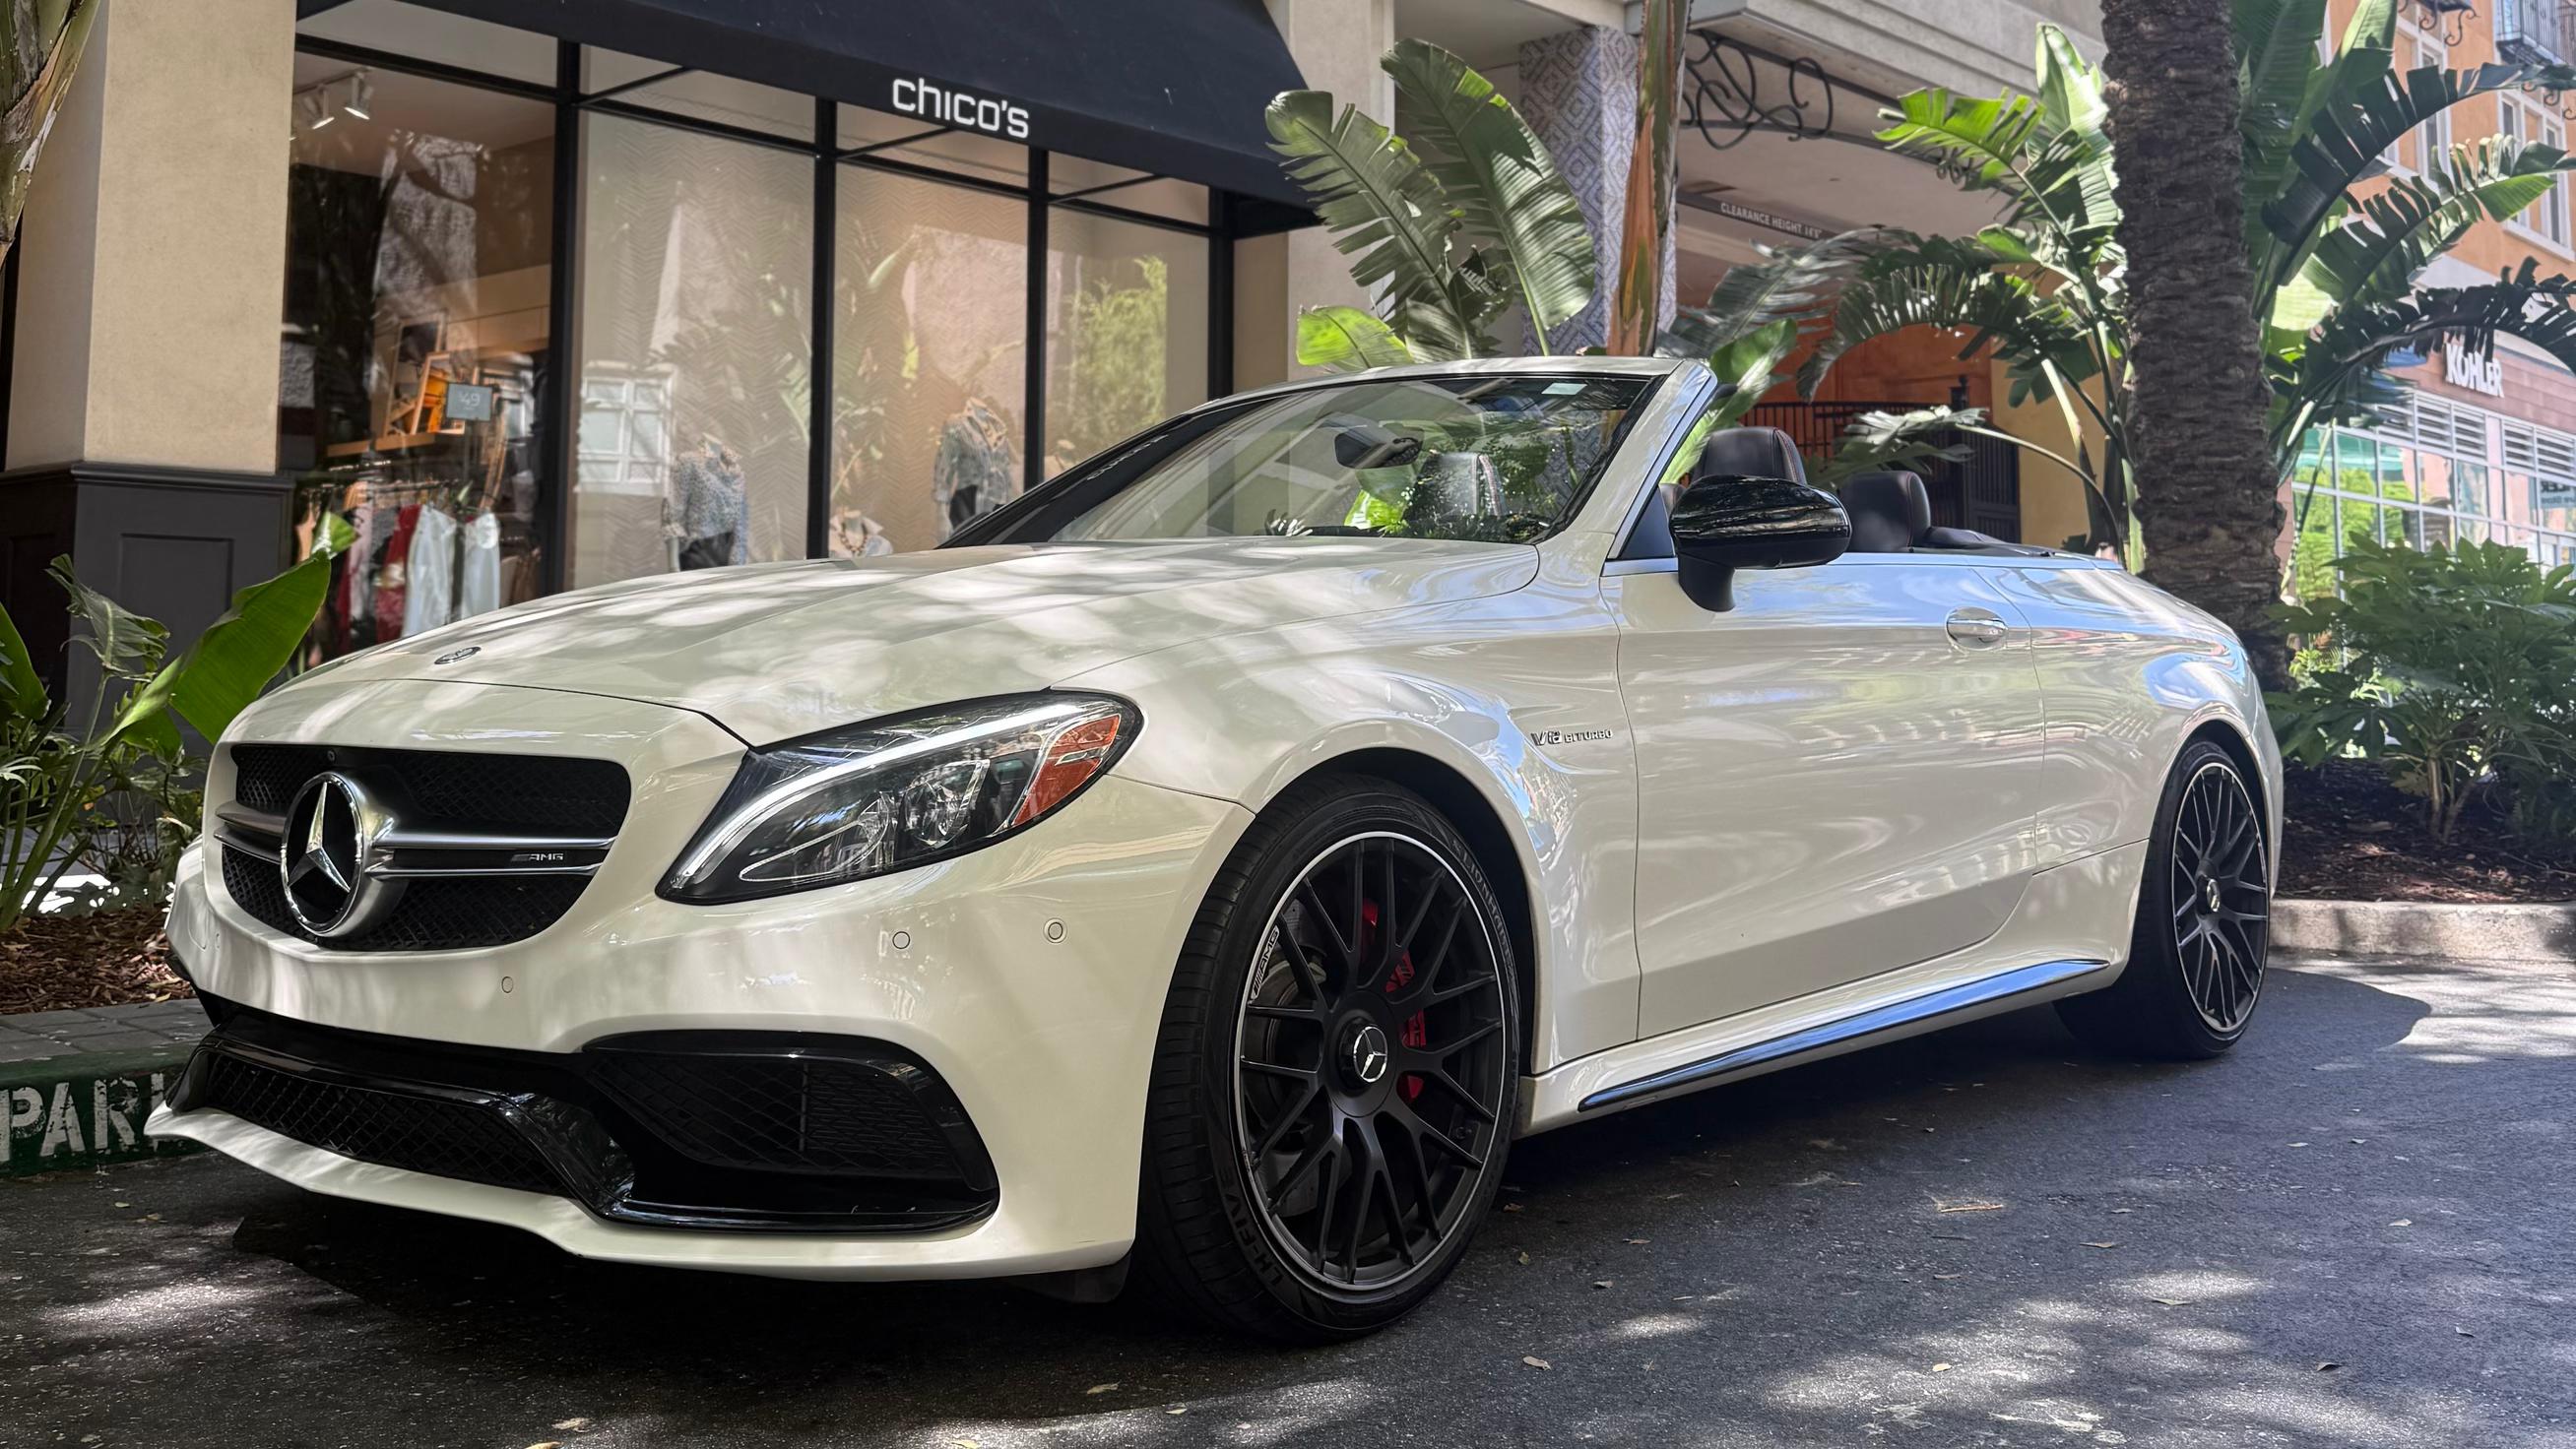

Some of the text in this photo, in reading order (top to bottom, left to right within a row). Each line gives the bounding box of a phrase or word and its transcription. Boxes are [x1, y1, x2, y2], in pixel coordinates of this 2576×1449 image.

[893, 77, 1030, 139] chico's
[1720, 202, 1771, 226] CLEARANCE
[1771, 217, 1803, 234] HEIGHT
[2445, 342, 2505, 399] KOHLER
[1564, 728, 1613, 744] BITURBO
[528, 852, 564, 862] AMG
